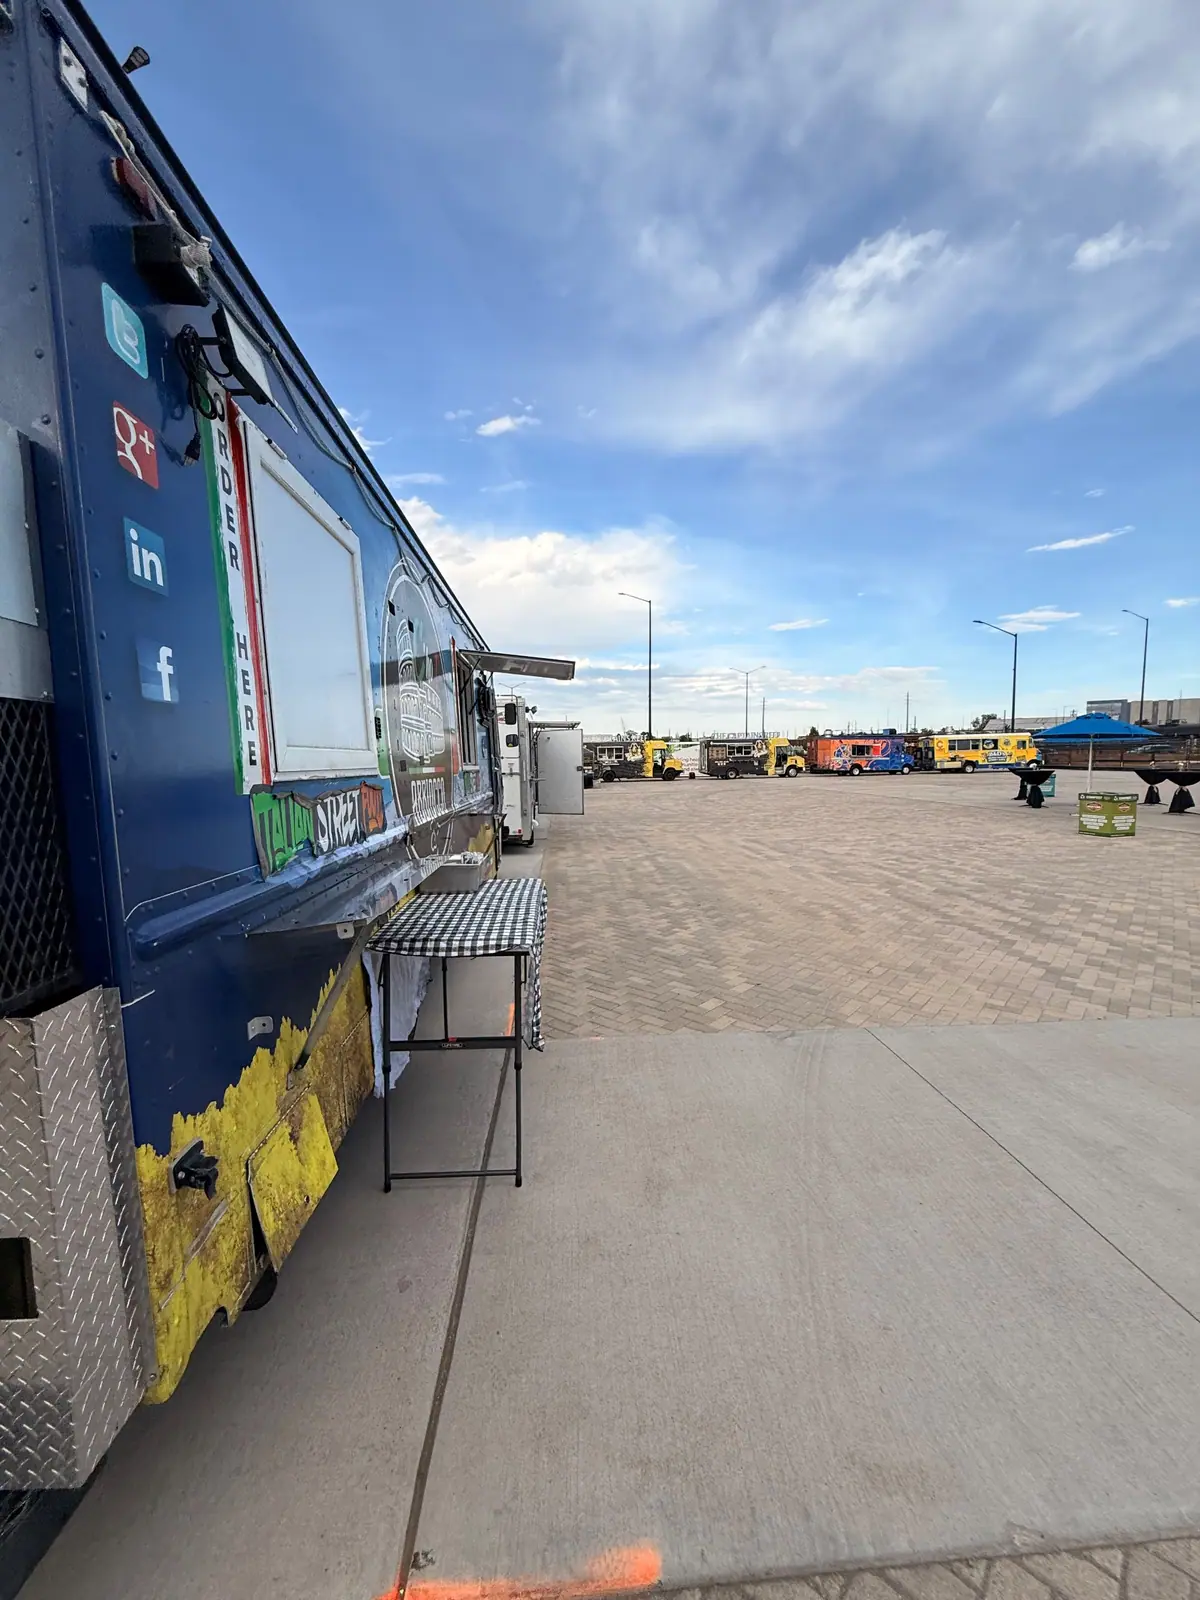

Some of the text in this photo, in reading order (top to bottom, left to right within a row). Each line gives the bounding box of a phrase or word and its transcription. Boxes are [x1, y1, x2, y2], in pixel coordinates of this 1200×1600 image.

[129, 527, 164, 588] in
[213, 391, 257, 766] ORDER HERE
[156, 645, 174, 702] f
[316, 788, 362, 852] STREET
